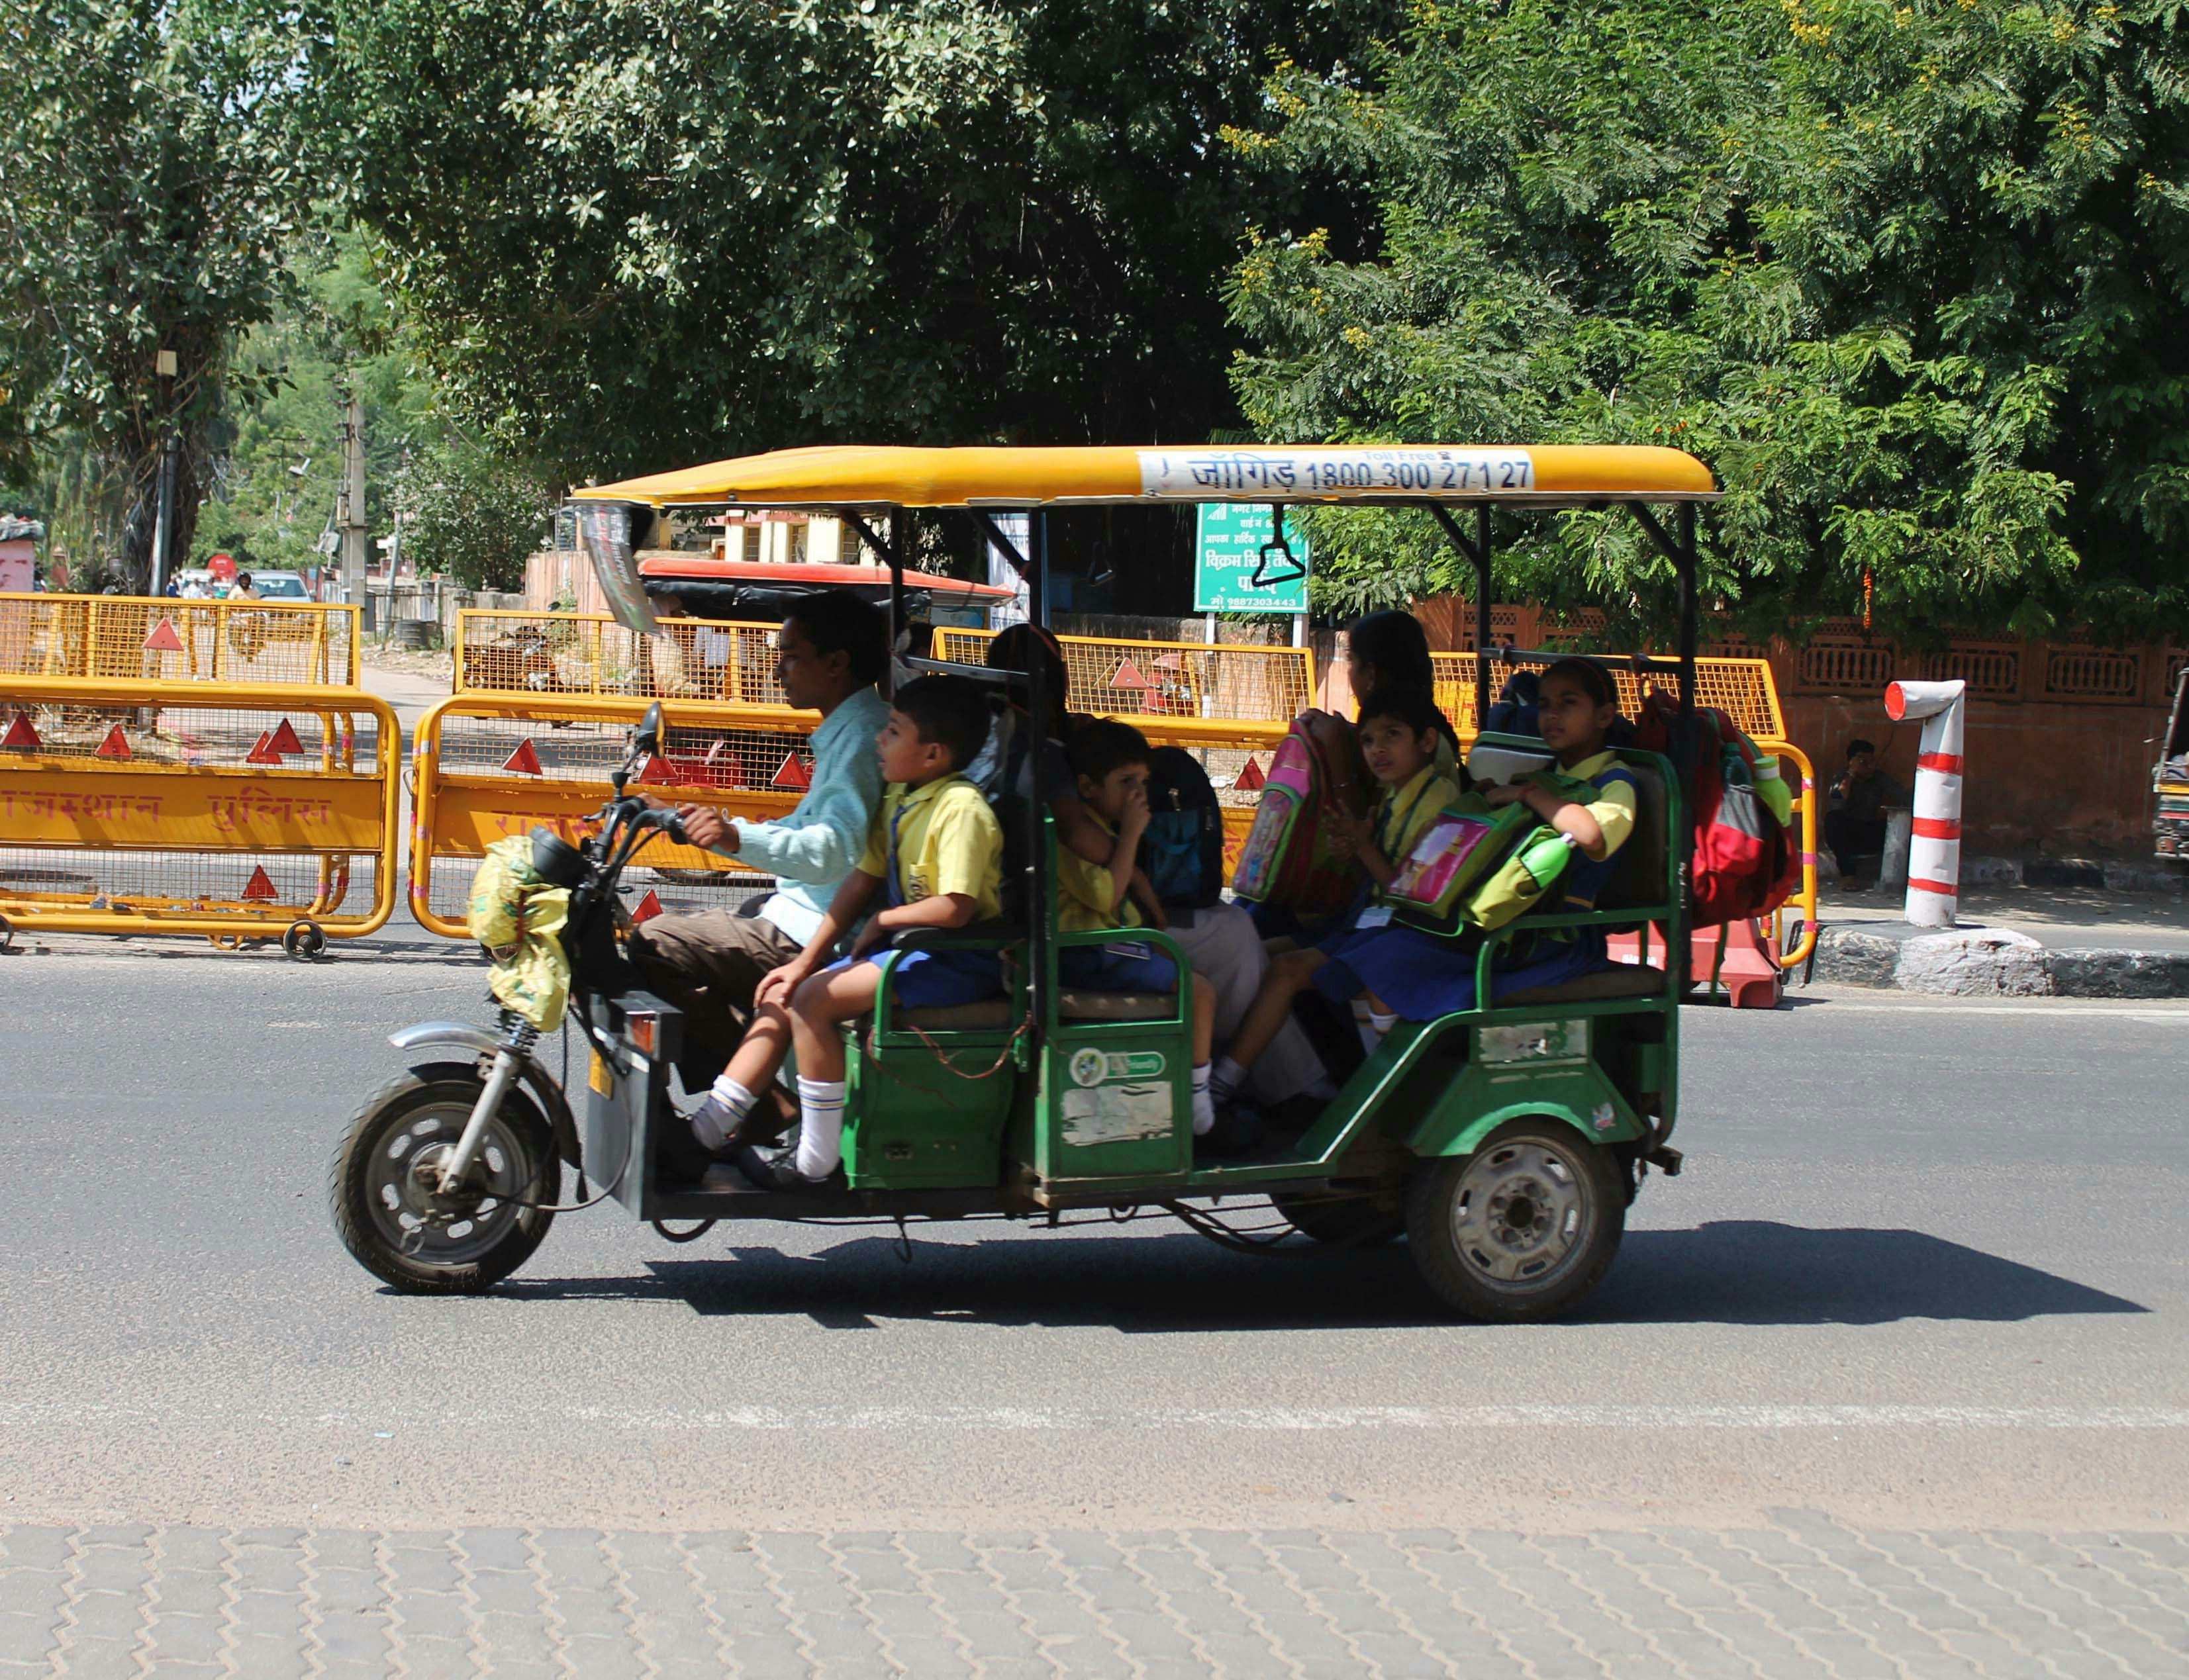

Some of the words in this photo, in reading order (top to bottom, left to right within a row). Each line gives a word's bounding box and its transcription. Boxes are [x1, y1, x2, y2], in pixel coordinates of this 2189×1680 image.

[1361, 451, 1394, 461] Toll
[1397, 451, 1436, 461] Free
[1306, 462, 1372, 490] 1800
[1381, 463, 1431, 489] 300
[1227, 598, 1296, 606] 9887303443
[207, 786, 332, 832] पुलिस
